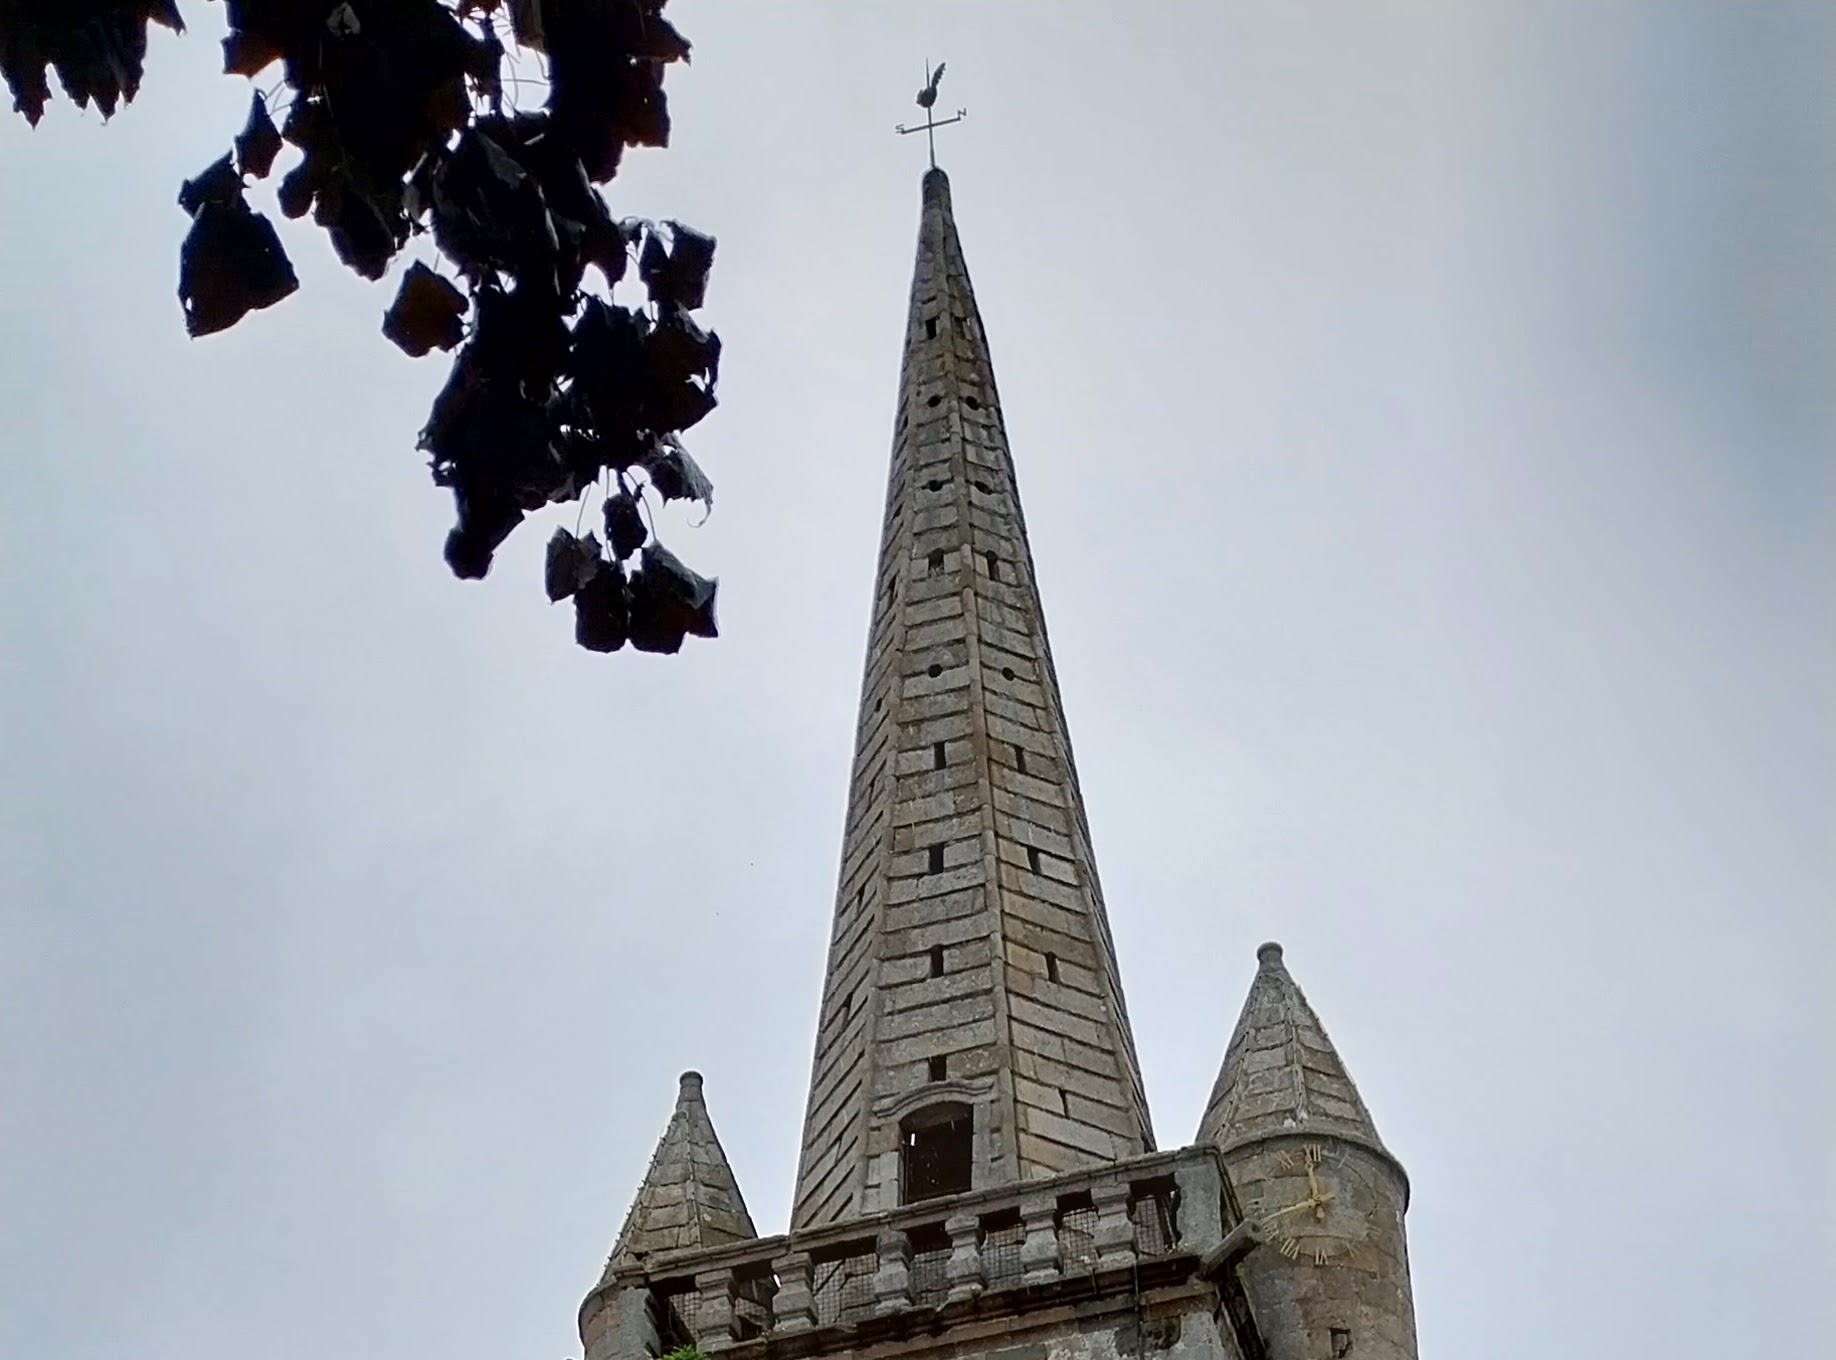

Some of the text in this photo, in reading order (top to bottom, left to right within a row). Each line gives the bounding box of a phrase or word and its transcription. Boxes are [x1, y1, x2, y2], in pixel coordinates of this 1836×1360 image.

[957, 107, 967, 120] N
[1304, 1144, 1322, 1162] XII
[1315, 1247, 1329, 1265] VI
